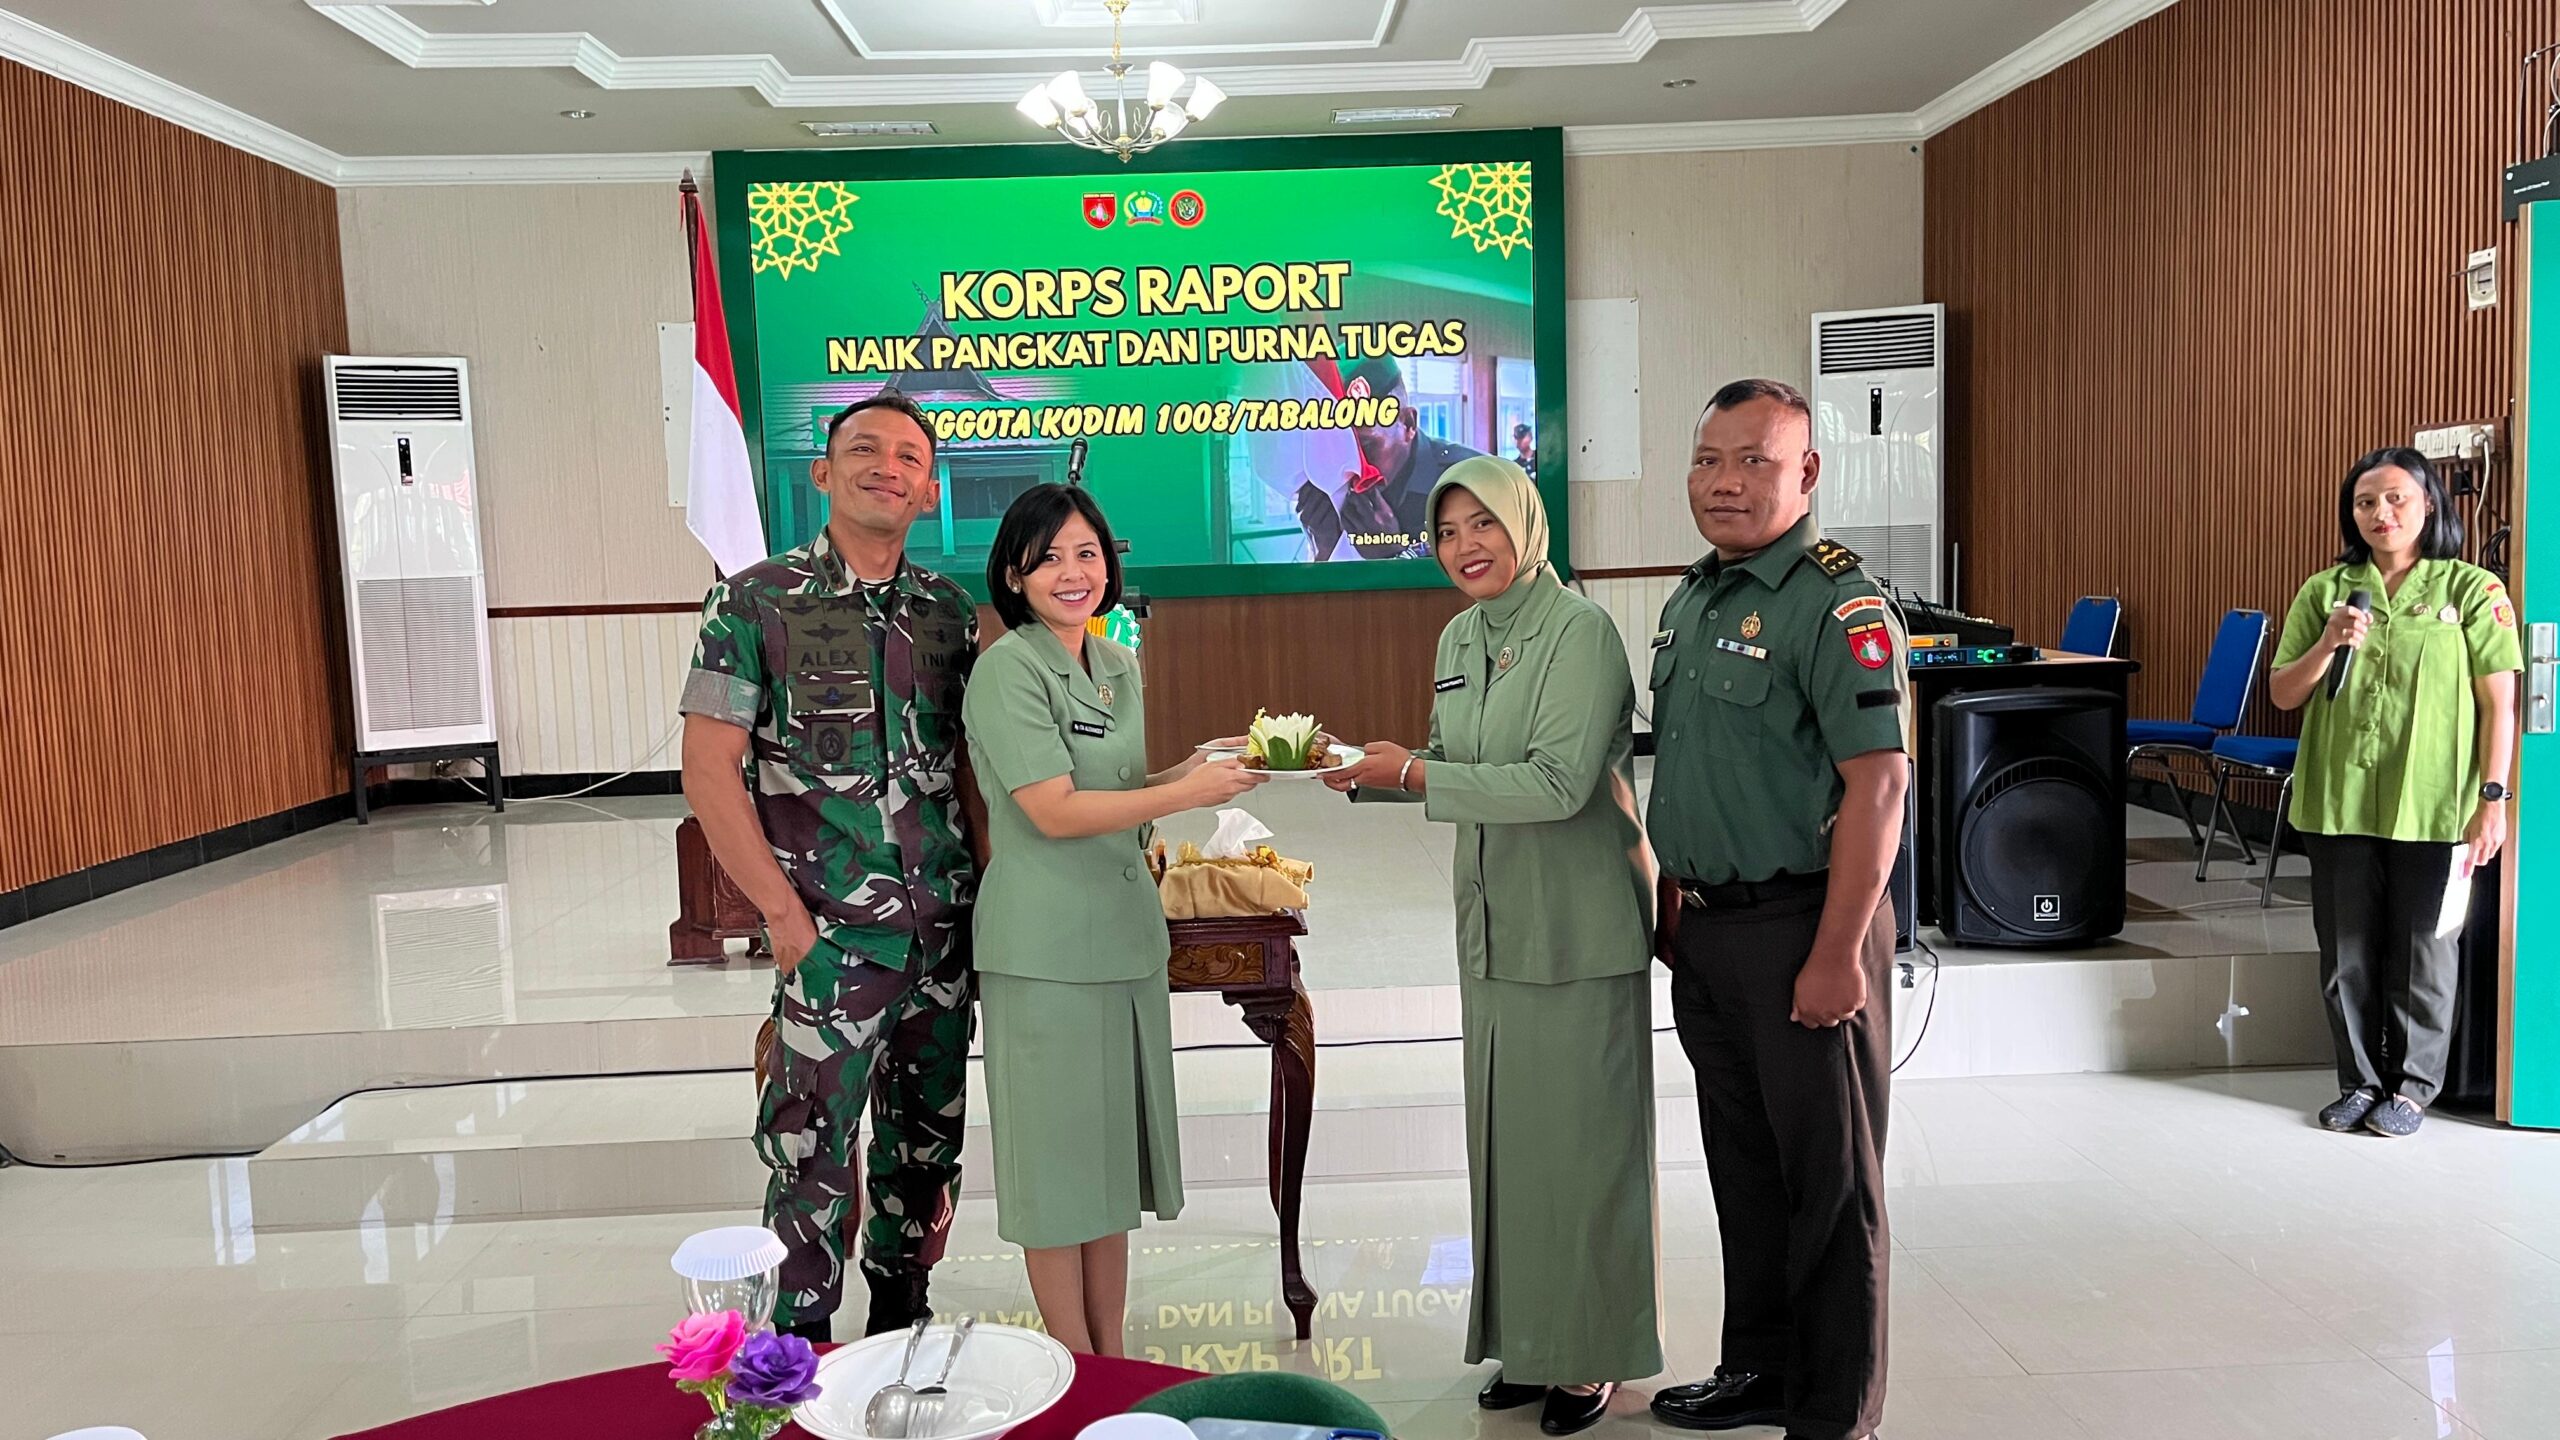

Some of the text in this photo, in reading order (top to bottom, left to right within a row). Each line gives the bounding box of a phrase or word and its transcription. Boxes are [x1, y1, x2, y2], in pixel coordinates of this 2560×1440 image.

[942, 262, 1350, 320] KORPS RAPORT
[828, 320, 1466, 373] NAIK PANGKAT DAN PURNA TUGAS
[926, 396, 1400, 440] GGOTA KODIM 1008/TABALONG
[1347, 532, 1410, 547] Tabalong
[800, 649, 858, 668] ALEX
